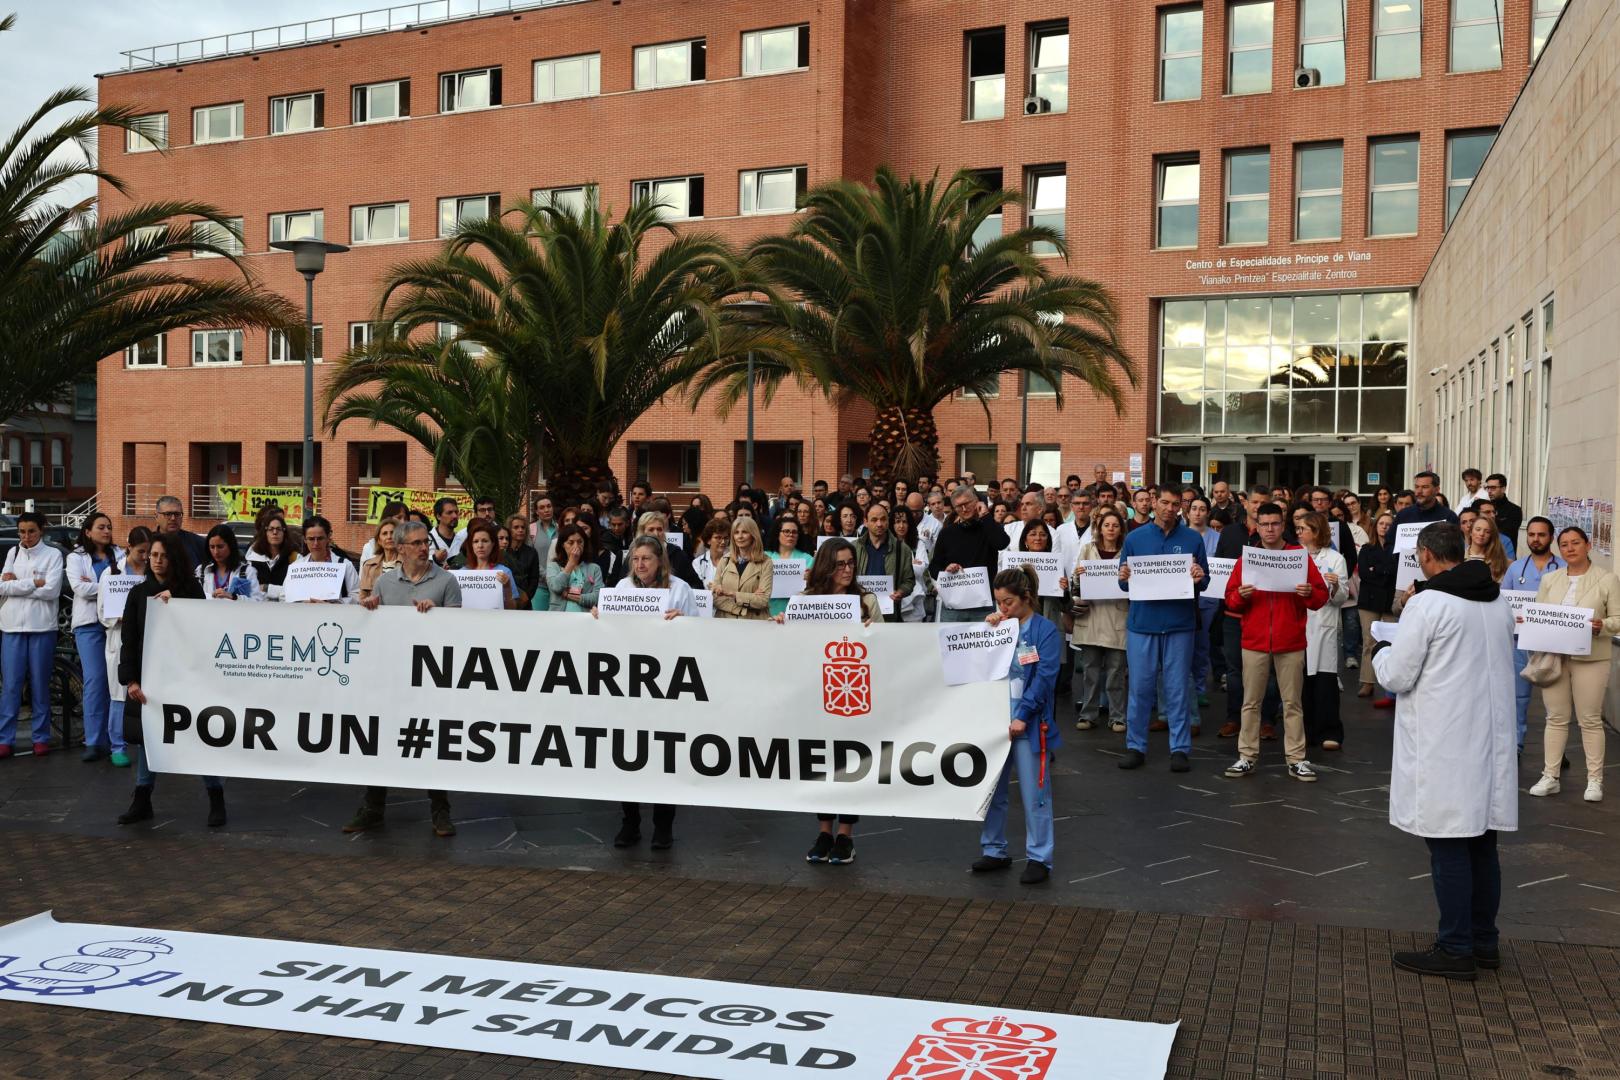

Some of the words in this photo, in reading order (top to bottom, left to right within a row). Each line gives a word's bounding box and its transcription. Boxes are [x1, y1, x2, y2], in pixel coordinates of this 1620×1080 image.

[1186, 260, 1212, 270] Centro
[1217, 259, 1227, 268] de
[1231, 256, 1291, 269] Especialidades
[1333, 253, 1344, 262] de
[1348, 251, 1371, 261] Viana
[1272, 271, 1322, 283] Espezialitate
[1326, 270, 1357, 280] Zentroa
[1538, 610, 1568, 619] TAMBIÉN
[996, 627, 1011, 636] SOY
[948, 637, 1013, 651] TRAUMATÓLOGO
[215, 662, 247, 670] Agrupación
[412, 645, 709, 701] NAVARRA
[163, 704, 279, 750] POR
[298, 712, 379, 756] UN
[397, 718, 987, 787] #ESTATUTOMEDICO
[259, 961, 412, 988] SIN
[420, 975, 834, 1031] MÉDIC@S
[159, 982, 283, 1006] NO
[293, 995, 469, 1025] HAY
[472, 1014, 856, 1069] SANIDAD
